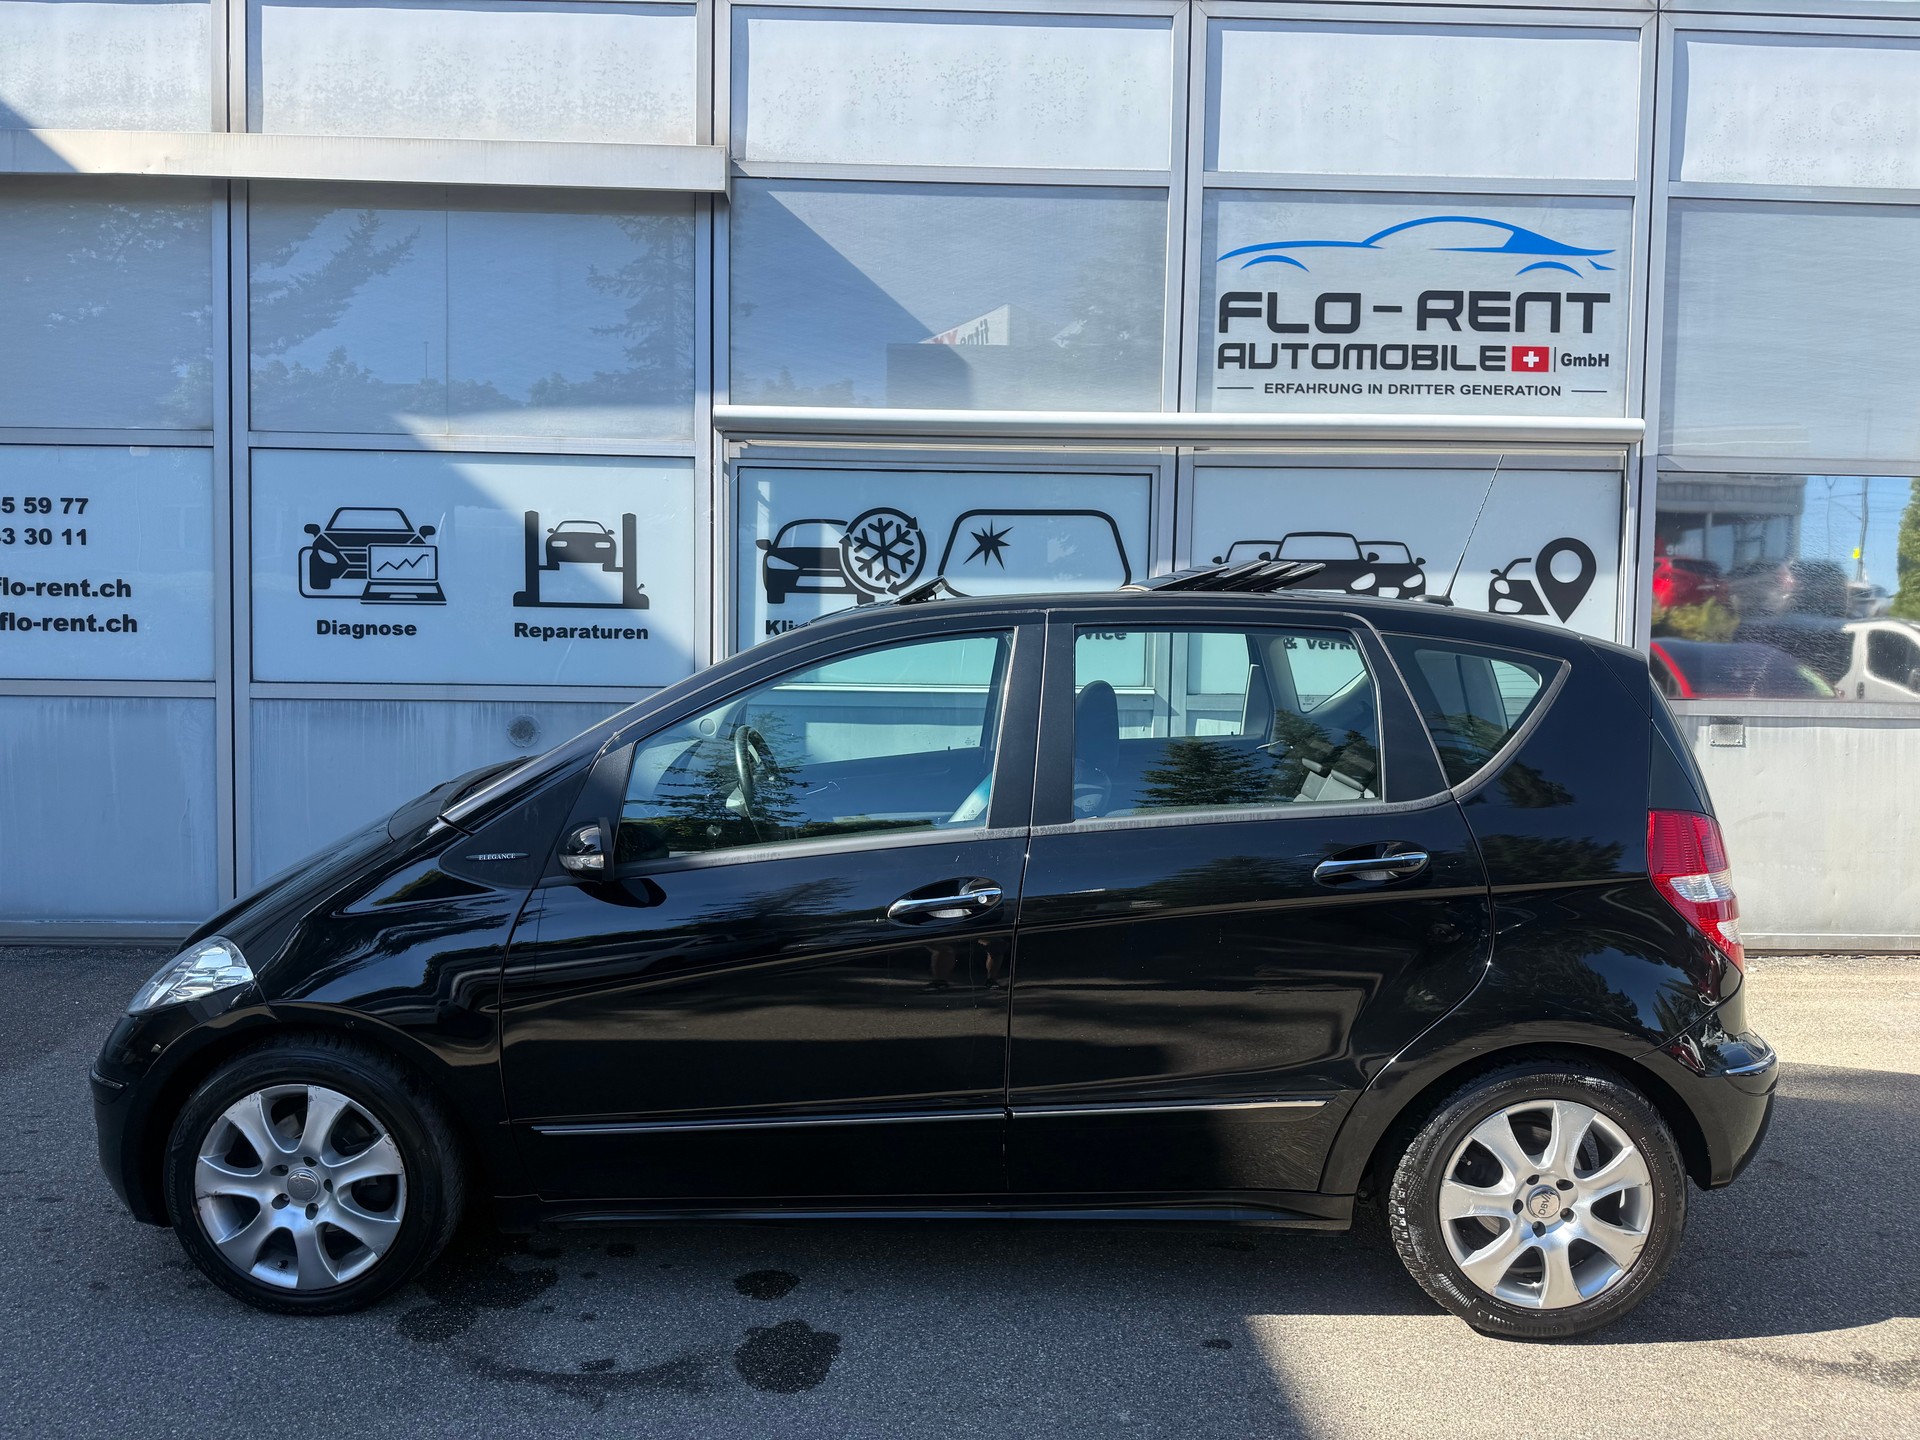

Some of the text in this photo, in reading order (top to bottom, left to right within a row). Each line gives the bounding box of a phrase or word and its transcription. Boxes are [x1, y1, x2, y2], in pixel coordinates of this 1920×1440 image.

[1217, 343, 1610, 372] AUTOMOBILE GmbH
[1264, 383, 1562, 397] ERFAHRUNG IN DRITTER GENERATION
[23, 497, 52, 514] 59
[60, 498, 89, 514] 77
[0, 528, 87, 545] 3 30 11
[0, 577, 132, 597] lo-rent.ch
[316, 620, 417, 640] Diagnose
[514, 622, 649, 642] Reparaturen
[765, 619, 799, 635] Kli
[1084, 632, 1127, 641] vice
